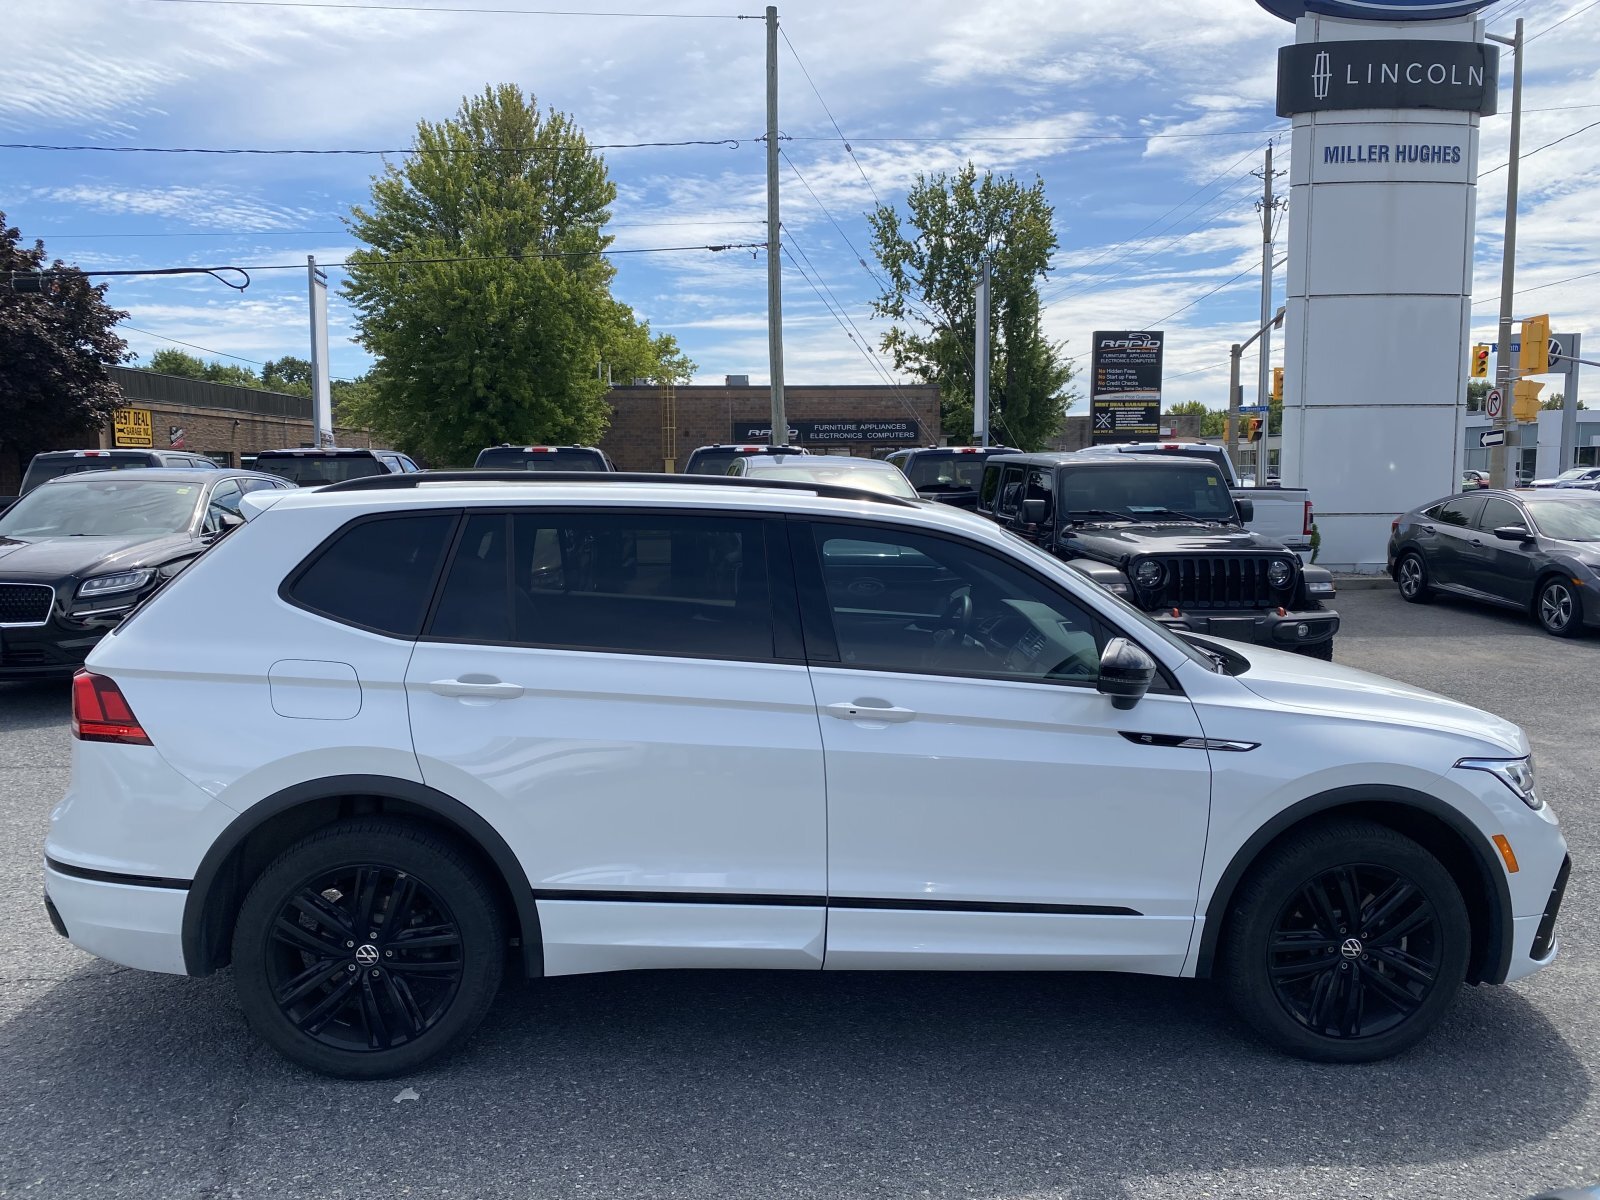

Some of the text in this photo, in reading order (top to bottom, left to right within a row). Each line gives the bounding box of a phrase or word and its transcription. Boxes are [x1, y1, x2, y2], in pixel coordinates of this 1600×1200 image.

[1346, 62, 1484, 87] LINCOLN
[1324, 144, 1461, 164] MILLER HUGHES
[116, 410, 149, 426] BEST DEAL
[126, 427, 142, 435] GARAGE
